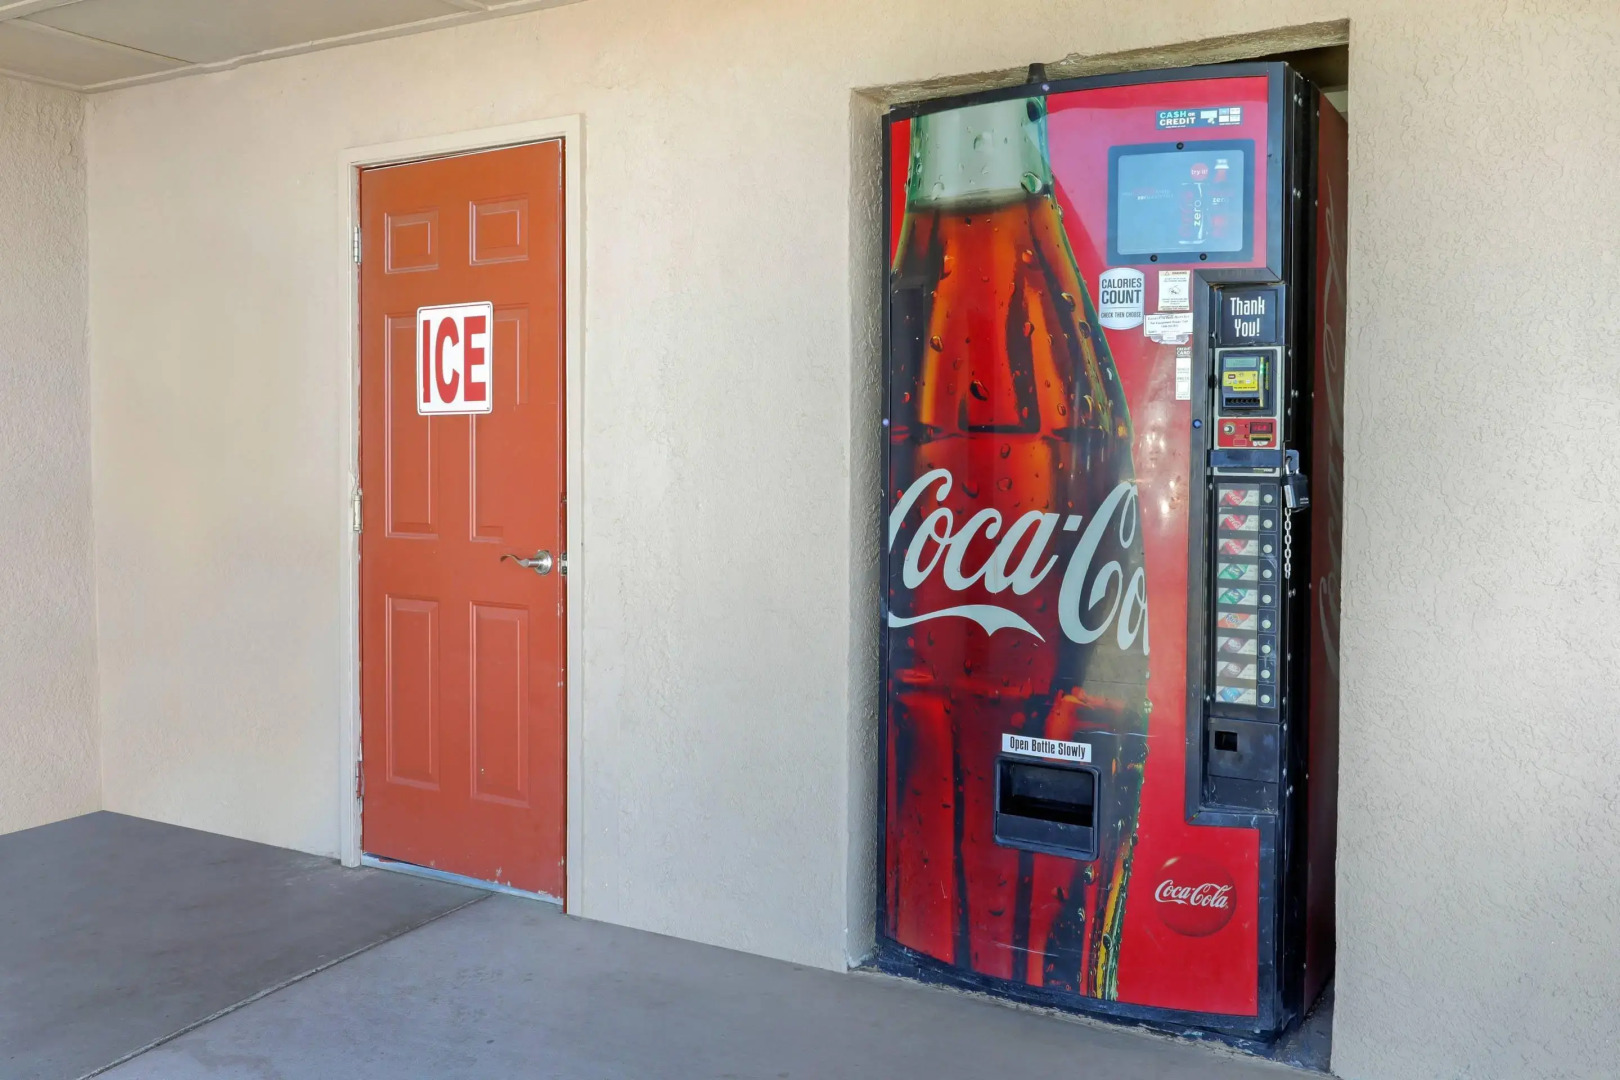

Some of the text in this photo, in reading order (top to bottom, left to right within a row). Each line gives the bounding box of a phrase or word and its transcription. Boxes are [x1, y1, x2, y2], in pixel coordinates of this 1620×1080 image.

[1160, 111, 1187, 119] CASH
[1160, 117, 1196, 126] CREDIT
[1194, 199, 1202, 227] zero
[1101, 278, 1142, 289] CALORIES
[1101, 290, 1142, 304] COUNT
[1230, 296, 1265, 316] Thank
[1234, 318, 1260, 337] You!
[423, 315, 486, 404] ICE
[889, 468, 1150, 656] Coca-Co
[1010, 736, 1086, 759] Open Bottle Slowly
[1155, 879, 1233, 909] Coca-Cola
